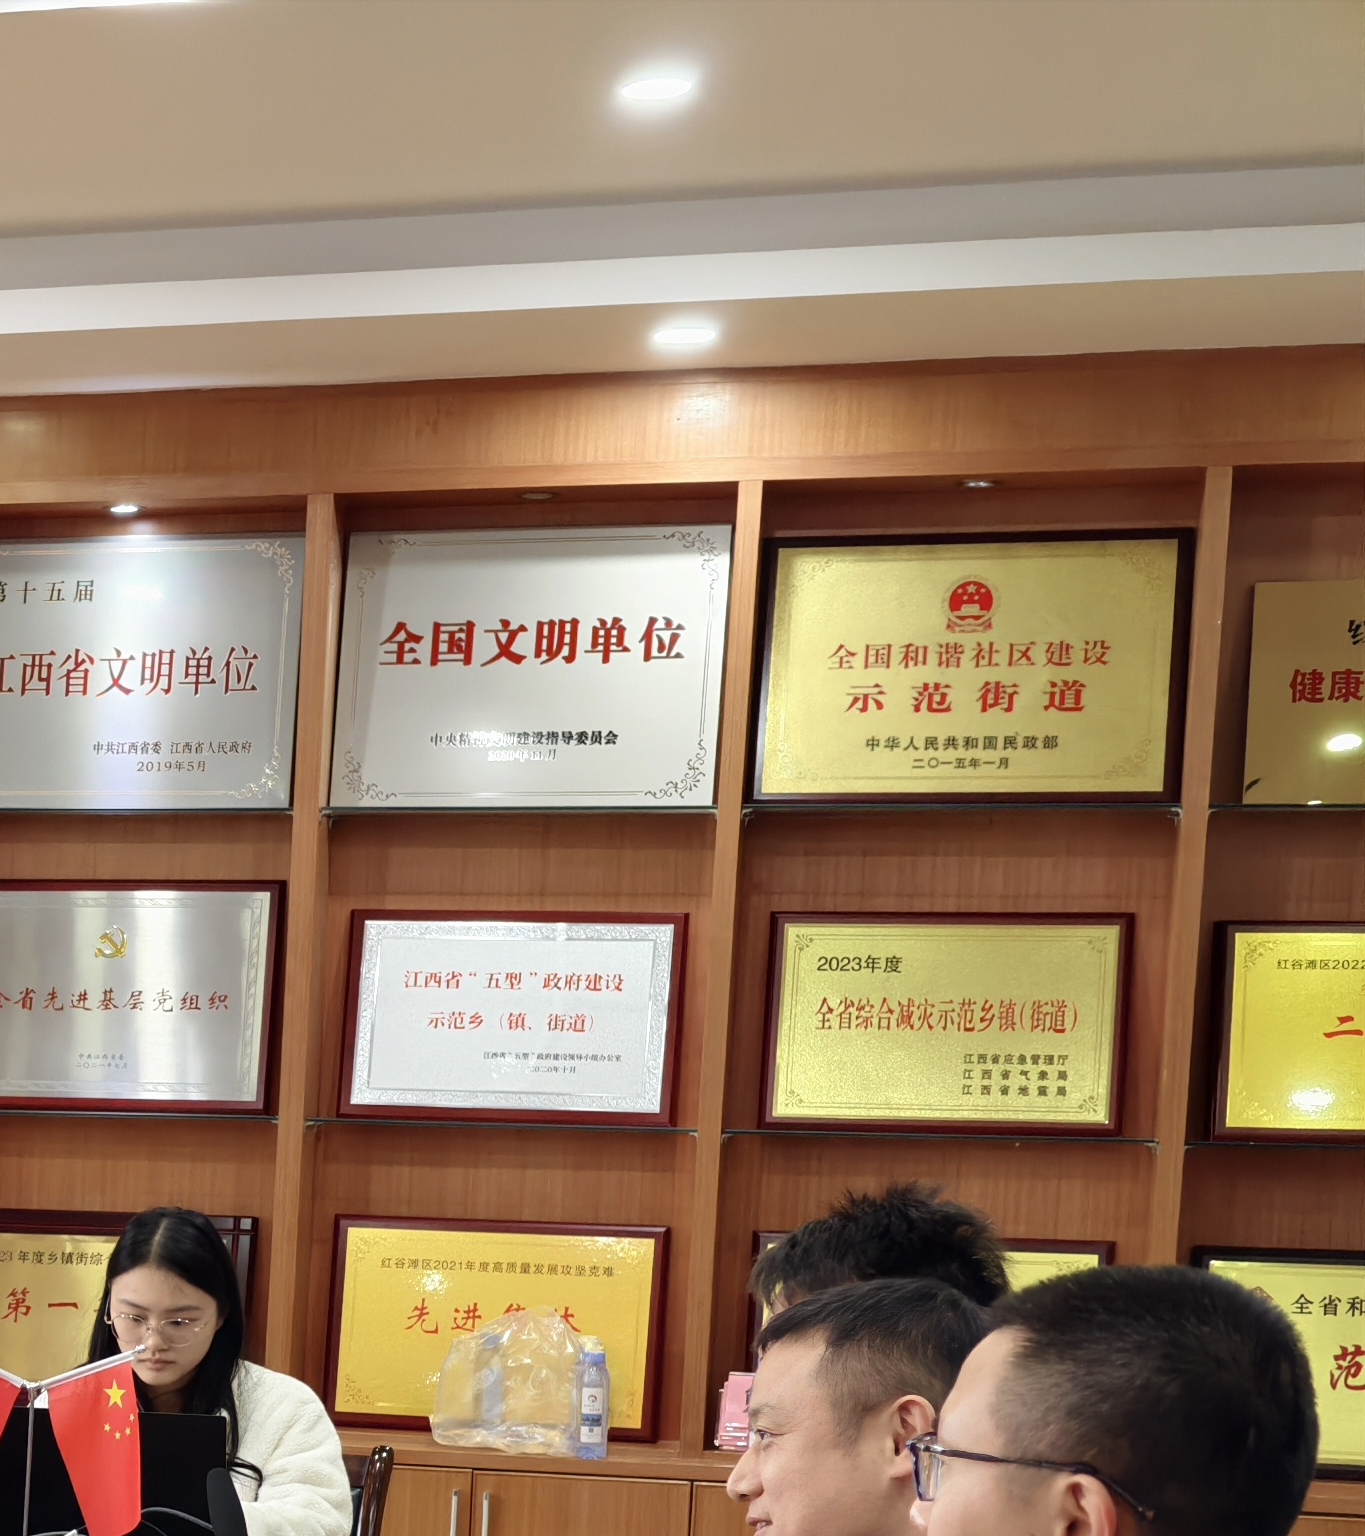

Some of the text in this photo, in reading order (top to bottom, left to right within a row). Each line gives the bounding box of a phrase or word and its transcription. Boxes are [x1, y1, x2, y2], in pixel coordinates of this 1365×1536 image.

[378, 615, 687, 668] 全国文明单位
[826, 639, 1113, 671] 全国和谐社区建设
[843, 679, 1088, 714] 示范街道
[92, 740, 253, 756] 中共江西省委 江西省人民政府
[865, 734, 1060, 752] 中华人民共和国民政部
[135, 760, 207, 773] 2019年5月
[816, 955, 904, 974] 2023年度
[1, 1287, 103, 1323] 第一
